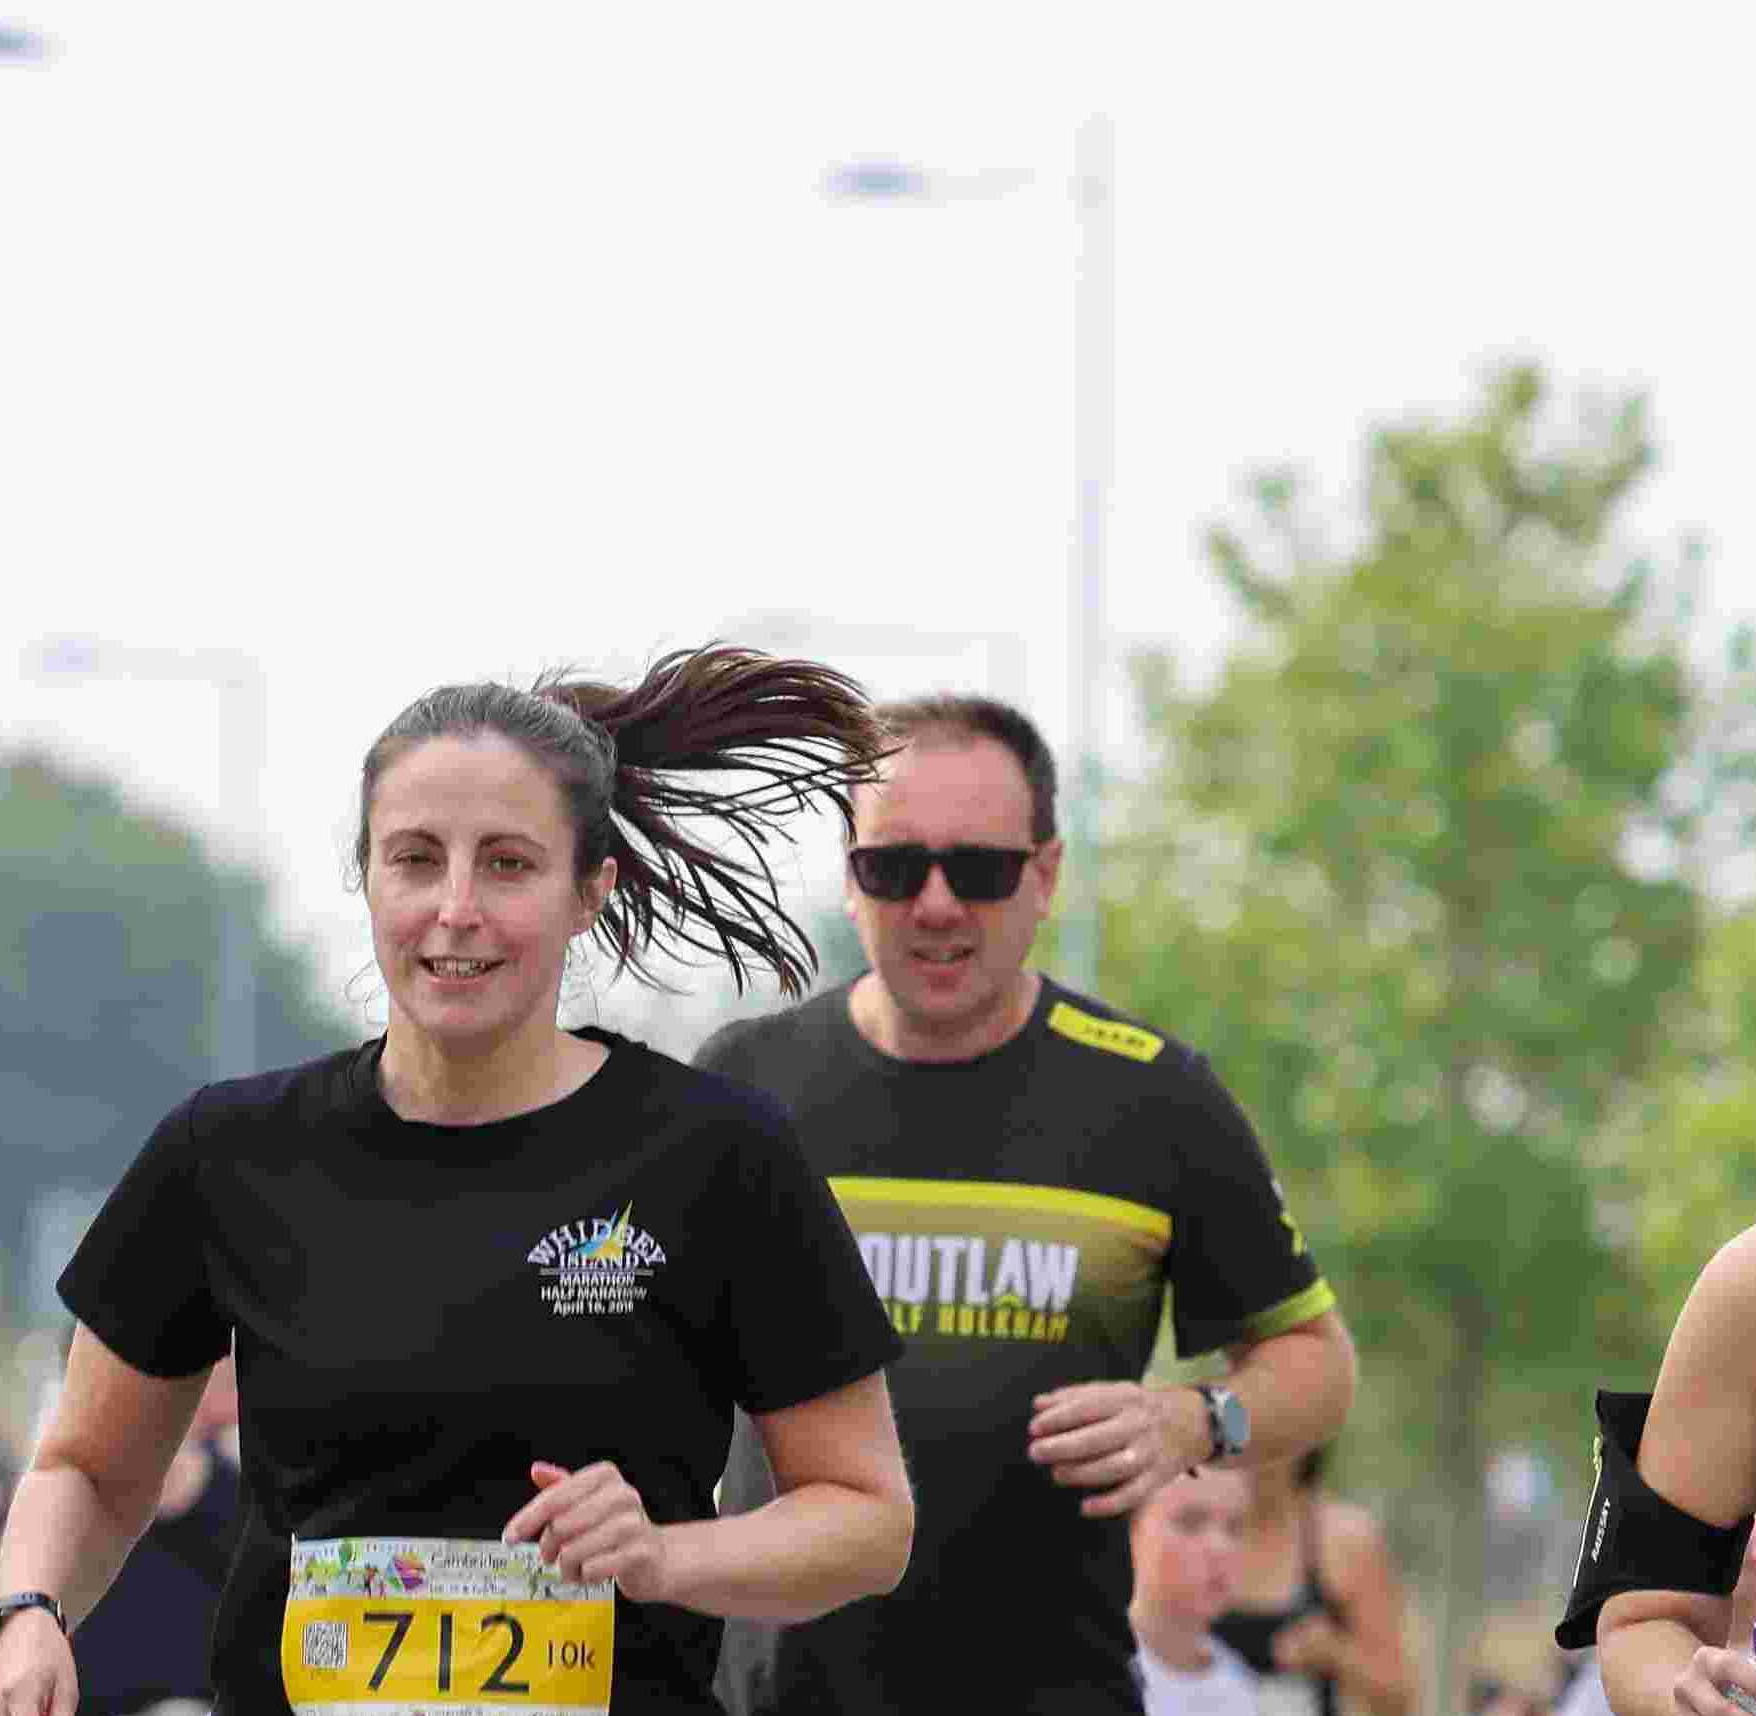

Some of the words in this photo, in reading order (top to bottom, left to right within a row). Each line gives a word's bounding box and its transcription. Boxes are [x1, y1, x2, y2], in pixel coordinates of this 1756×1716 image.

[553, 1300, 583, 1318] April
[363, 1611, 530, 1693] 712
[547, 1641, 595, 1671] 10k
